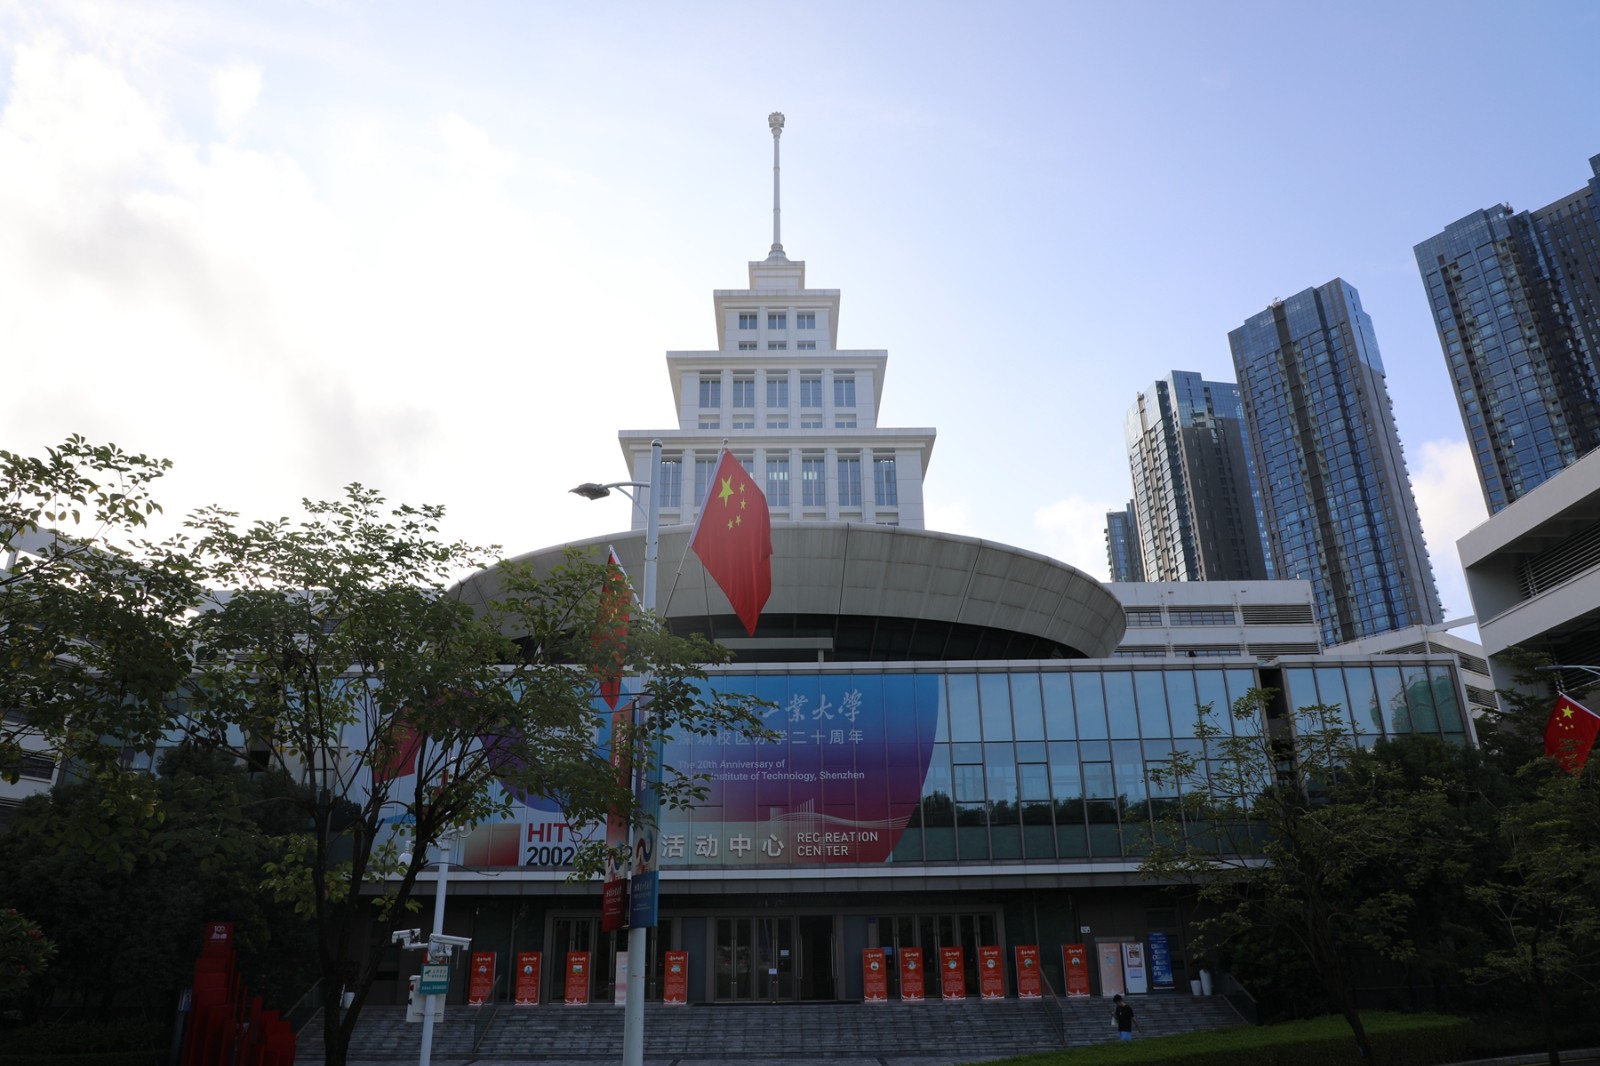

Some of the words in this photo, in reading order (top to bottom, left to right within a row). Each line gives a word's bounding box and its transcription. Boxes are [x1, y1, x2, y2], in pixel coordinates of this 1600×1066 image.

[678, 760, 696, 769] The
[697, 760, 718, 769] 20th
[719, 760, 773, 770] Anniversary
[775, 759, 785, 768] of
[750, 771, 760, 781] of
[761, 771, 817, 782] Technology,
[819, 770, 865, 780] Shenzhen
[797, 831, 879, 843] RECREATION
[661, 834, 785, 858] 活动中心
[797, 845, 849, 856] CENTER
